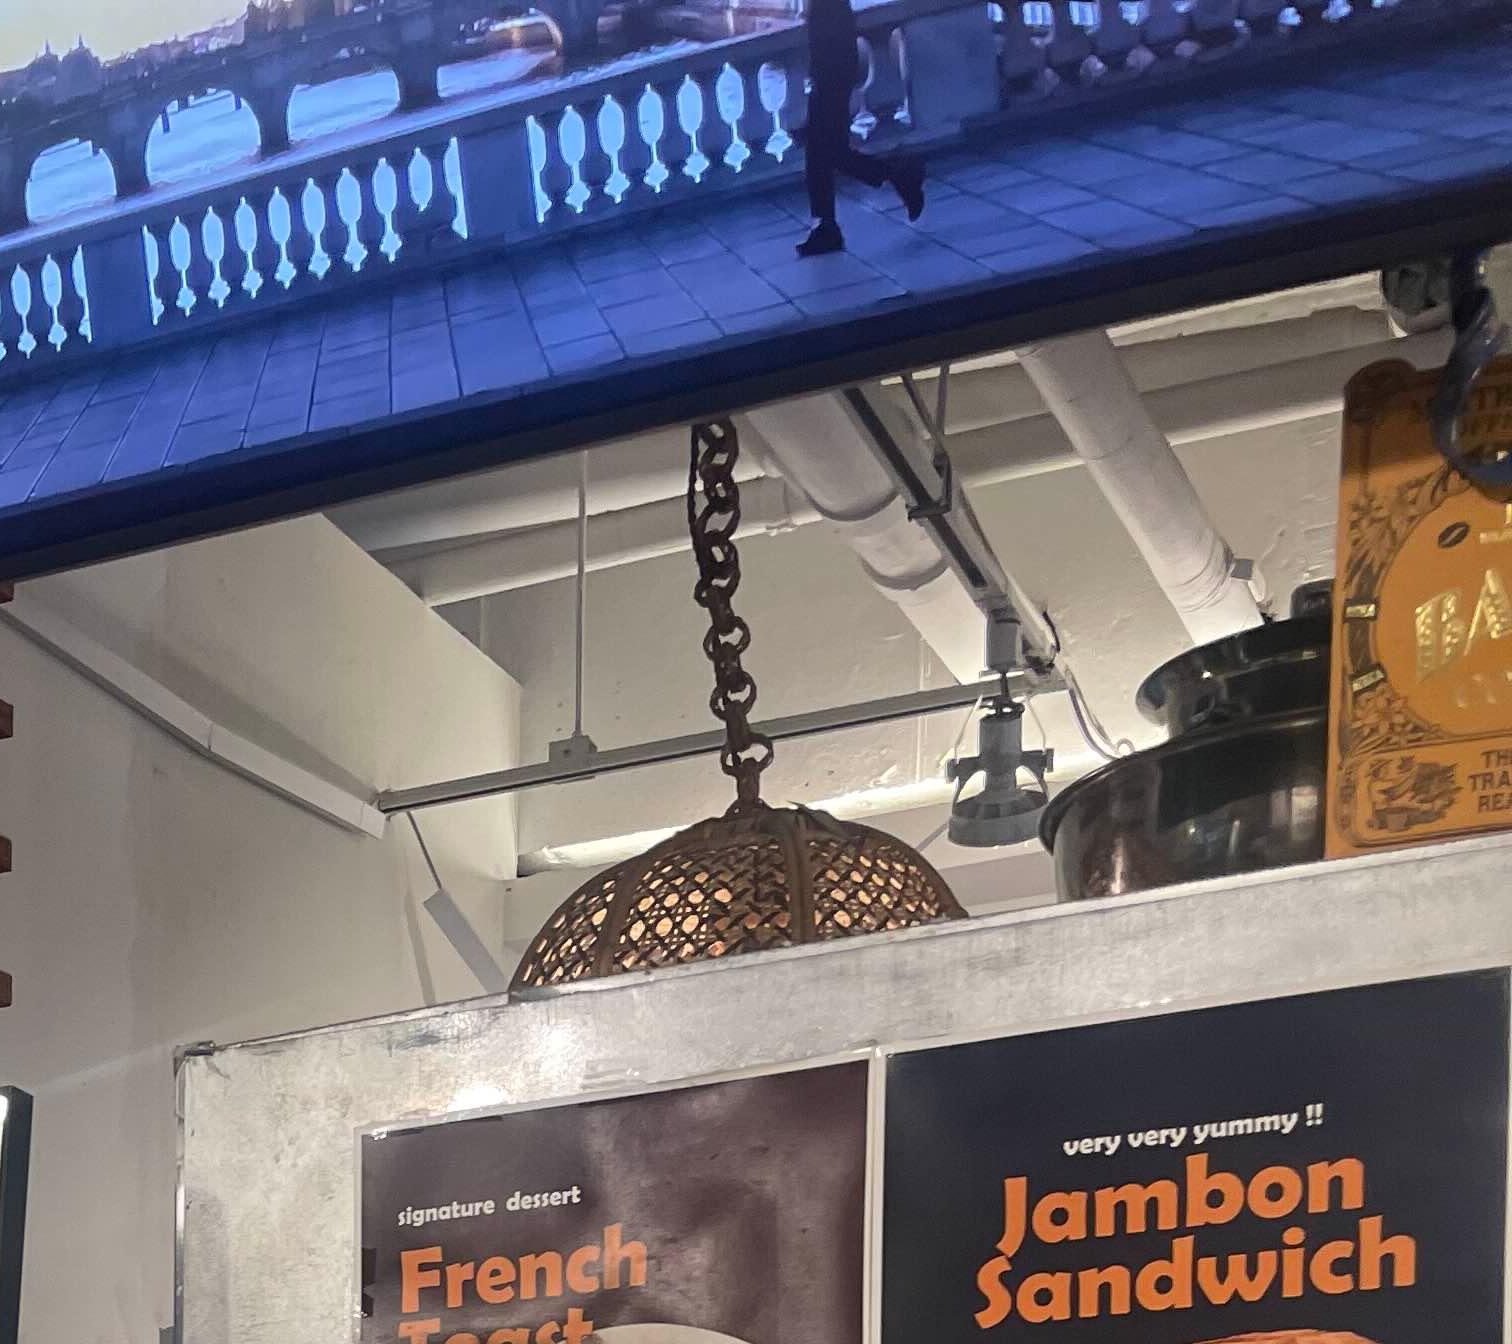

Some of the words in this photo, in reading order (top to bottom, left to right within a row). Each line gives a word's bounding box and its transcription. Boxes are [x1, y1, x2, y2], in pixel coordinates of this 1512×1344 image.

[1481, 748, 1512, 768] TH
[1062, 1133, 1122, 1156] very
[1127, 1125, 1187, 1150] very
[1193, 1109, 1298, 1142] yummy
[1305, 1103, 1324, 1126] !!
[397, 1197, 496, 1227] signature
[506, 1185, 582, 1213] dessert
[995, 1151, 1365, 1258] Jambon
[399, 1222, 648, 1314] French
[974, 1215, 1417, 1329] Sandwich
